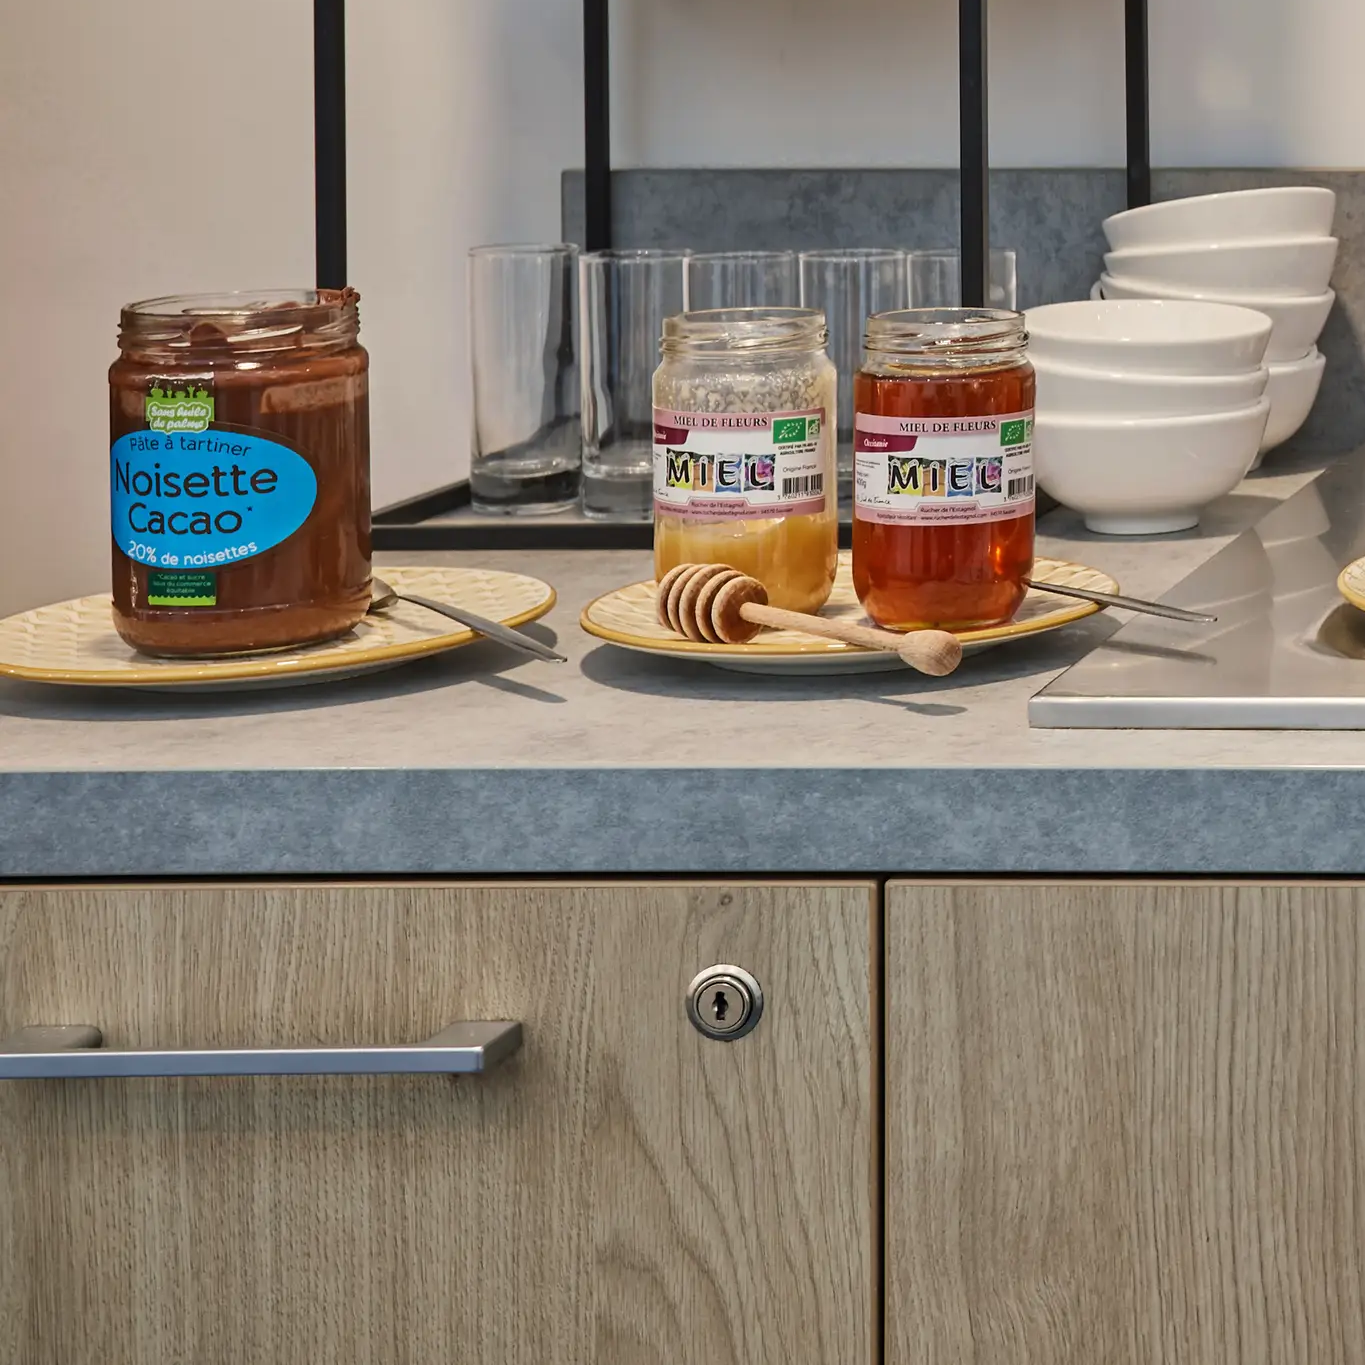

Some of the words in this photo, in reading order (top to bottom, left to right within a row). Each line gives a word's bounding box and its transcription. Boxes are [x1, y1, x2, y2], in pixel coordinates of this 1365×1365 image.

[673, 415, 699, 426] MIEL
[702, 417, 718, 427] DE
[721, 417, 768, 428] FLEURS
[899, 422, 929, 433] MIEL
[932, 422, 949, 432] DE
[953, 420, 996, 432] FLEURS
[129, 437, 159, 452] Pâte
[164, 435, 174, 450] à
[180, 436, 252, 457] tartiner
[115, 458, 278, 498] Noisette
[667, 452, 771, 488] MIEL
[889, 459, 998, 492] MIEL
[127, 540, 157, 563] 20%
[160, 552, 179, 566] de
[184, 541, 258, 566] noisettes
